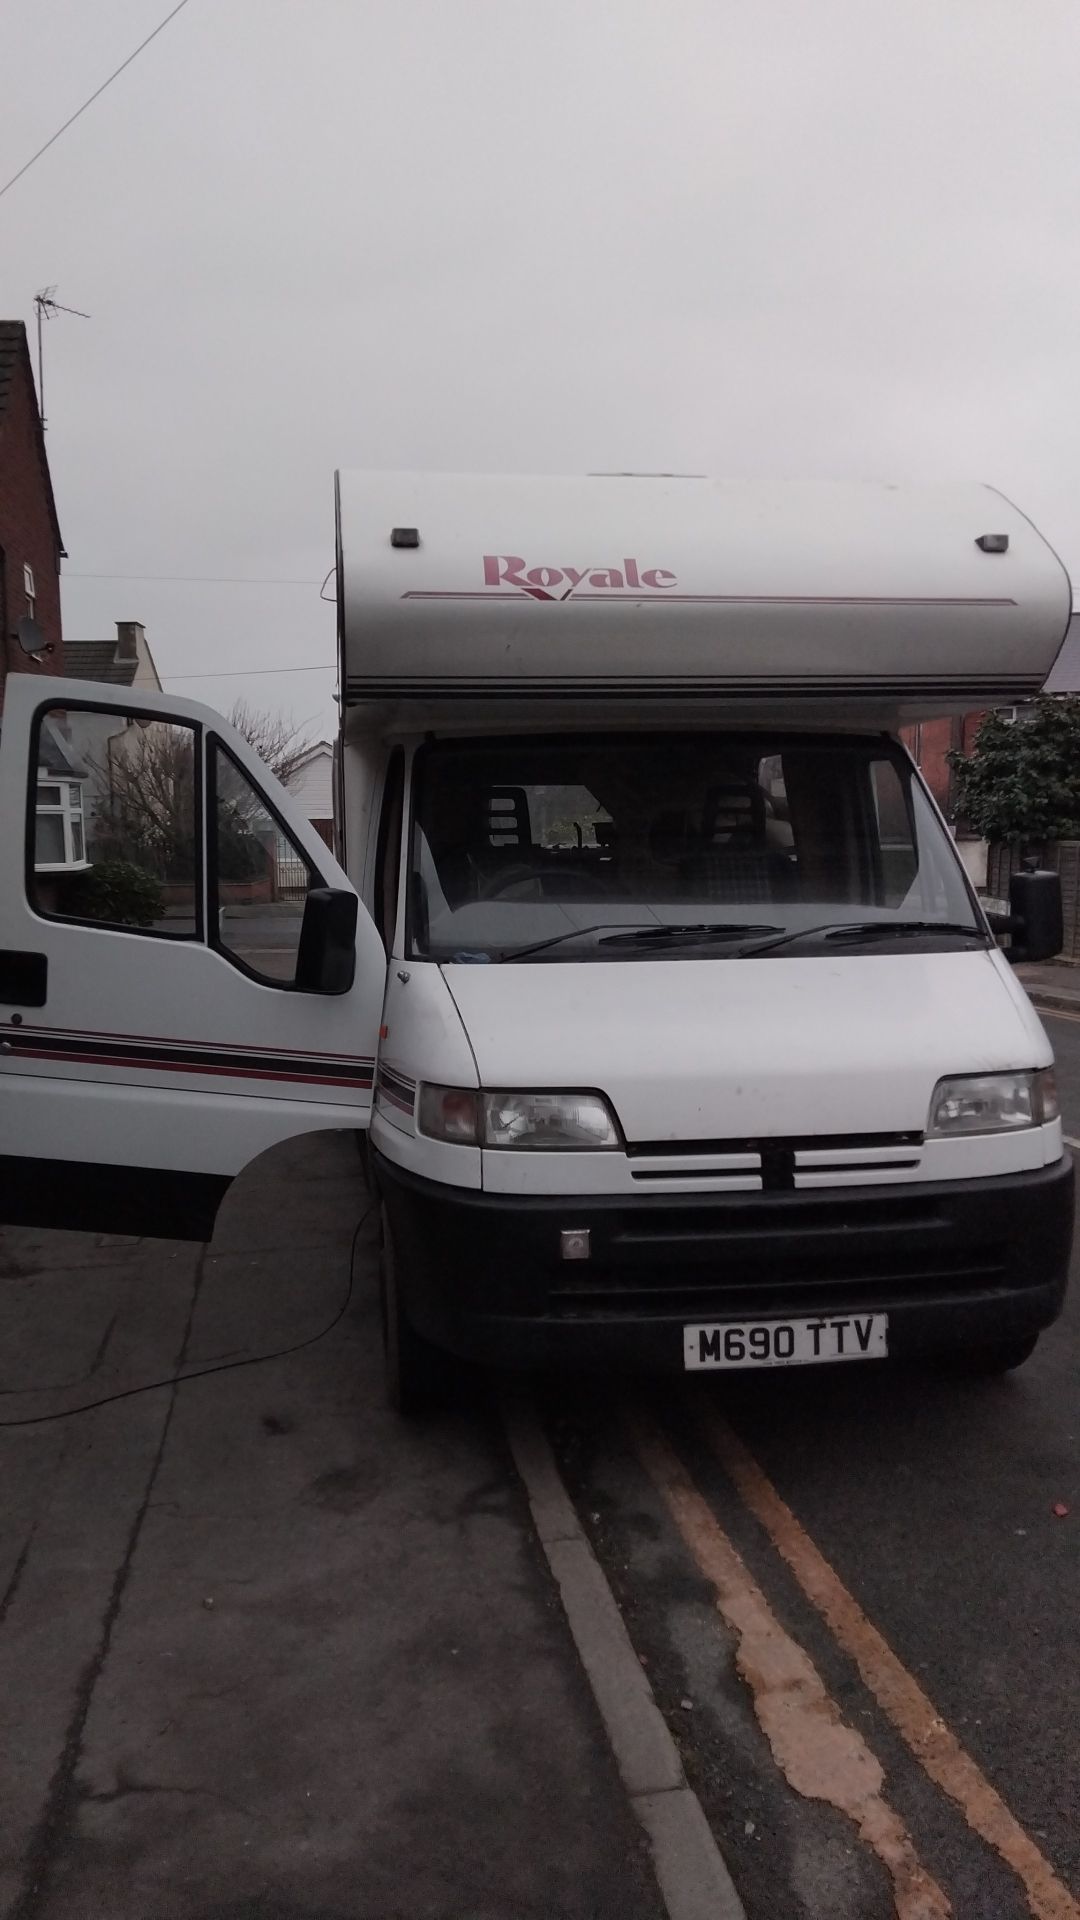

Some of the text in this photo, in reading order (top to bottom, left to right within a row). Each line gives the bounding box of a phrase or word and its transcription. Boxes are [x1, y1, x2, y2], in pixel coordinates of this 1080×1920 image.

[483, 555, 678, 589] Royale
[699, 1318, 874, 1362] M690 TTV
